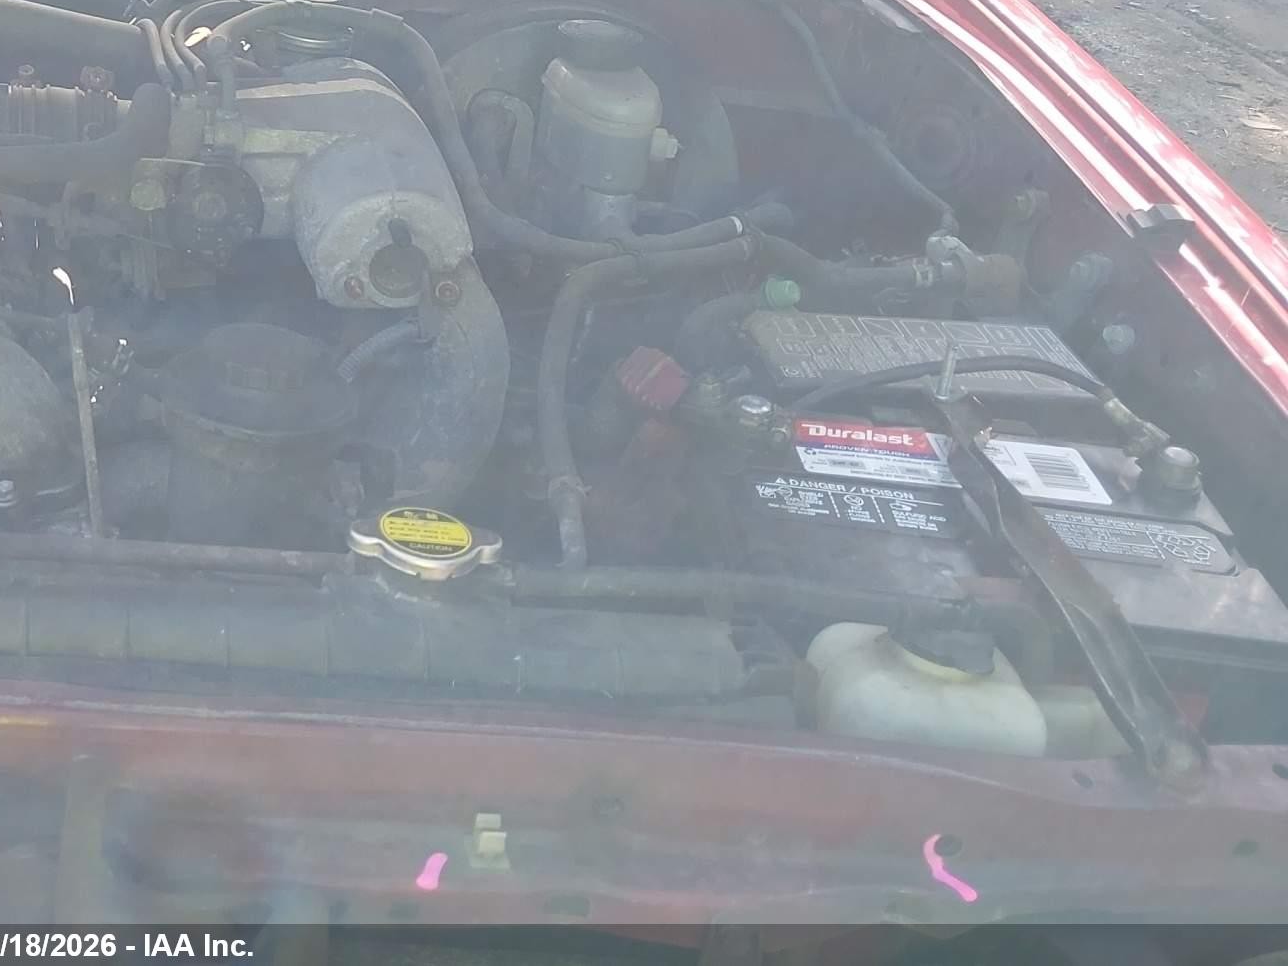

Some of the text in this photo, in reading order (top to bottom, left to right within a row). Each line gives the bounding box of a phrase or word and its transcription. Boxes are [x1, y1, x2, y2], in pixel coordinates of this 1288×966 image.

[801, 423, 914, 446] Duralast
[789, 478, 846, 492] DANGER
[860, 487, 915, 500] POISON
